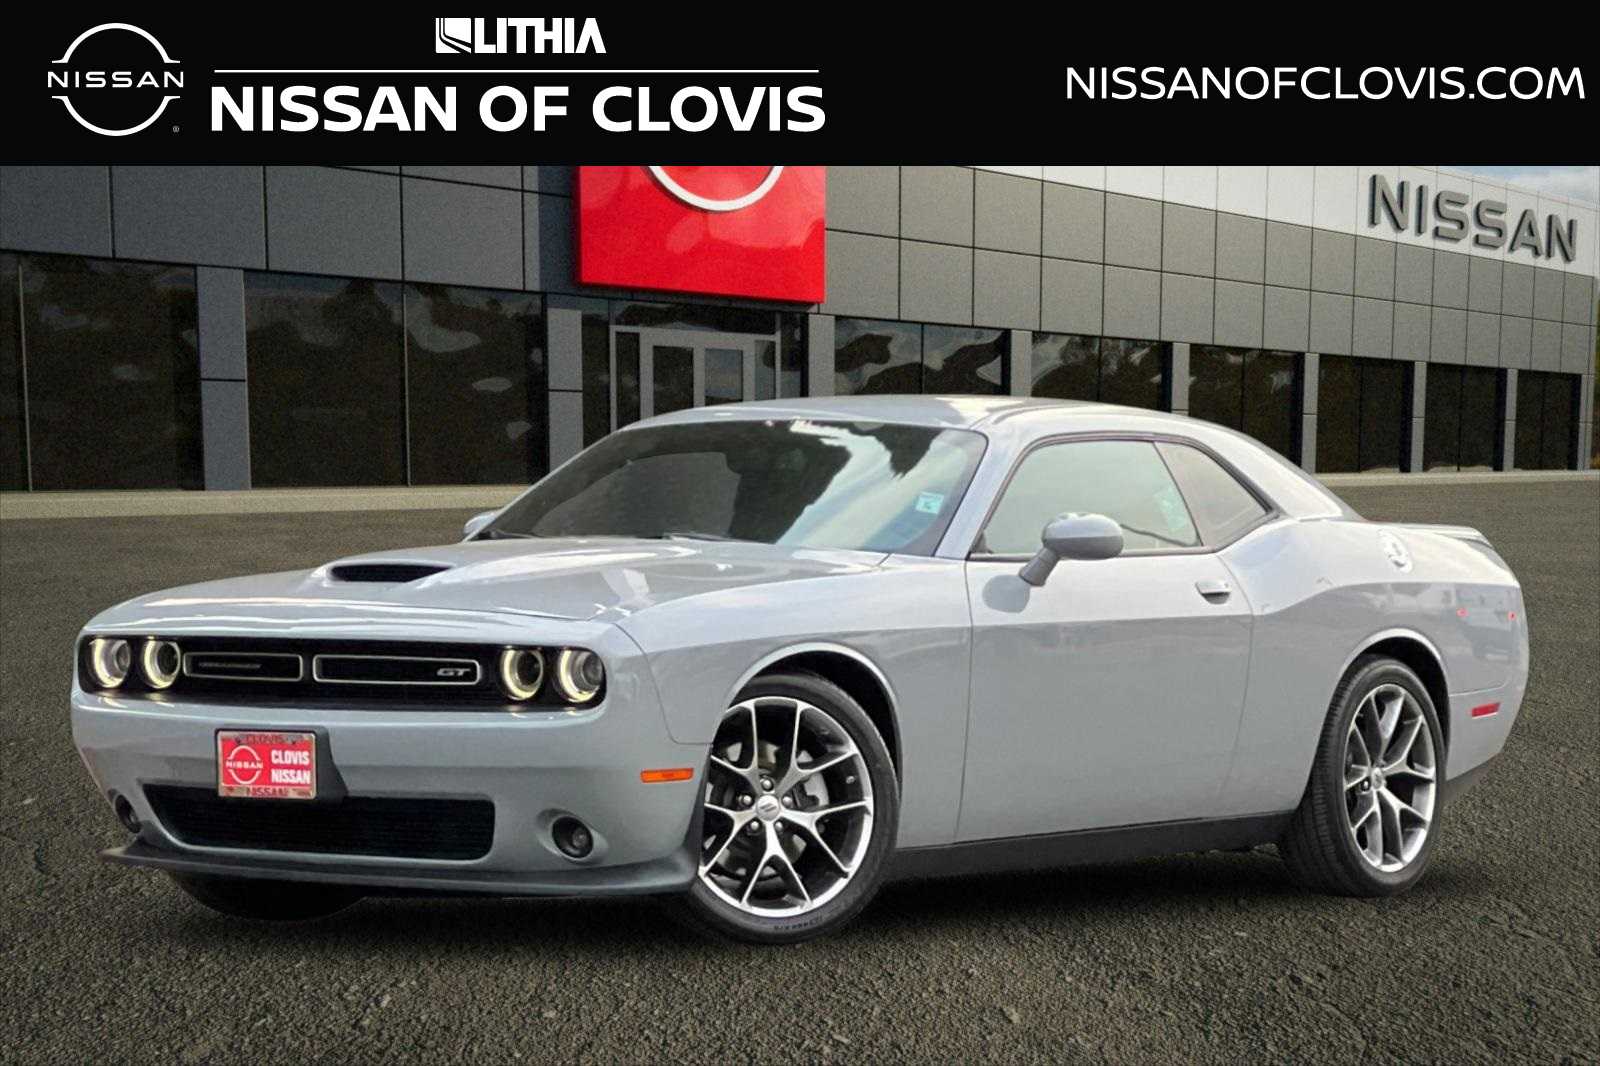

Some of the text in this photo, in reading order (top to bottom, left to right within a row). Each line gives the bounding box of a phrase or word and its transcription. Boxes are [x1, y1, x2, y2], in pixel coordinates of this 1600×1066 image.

[1368, 174, 1577, 262] NISSAN
[436, 667, 470, 677] GT
[225, 760, 264, 769] NISSAN
[271, 750, 310, 766] CLOVIS
[271, 768, 311, 784] NISSAN
